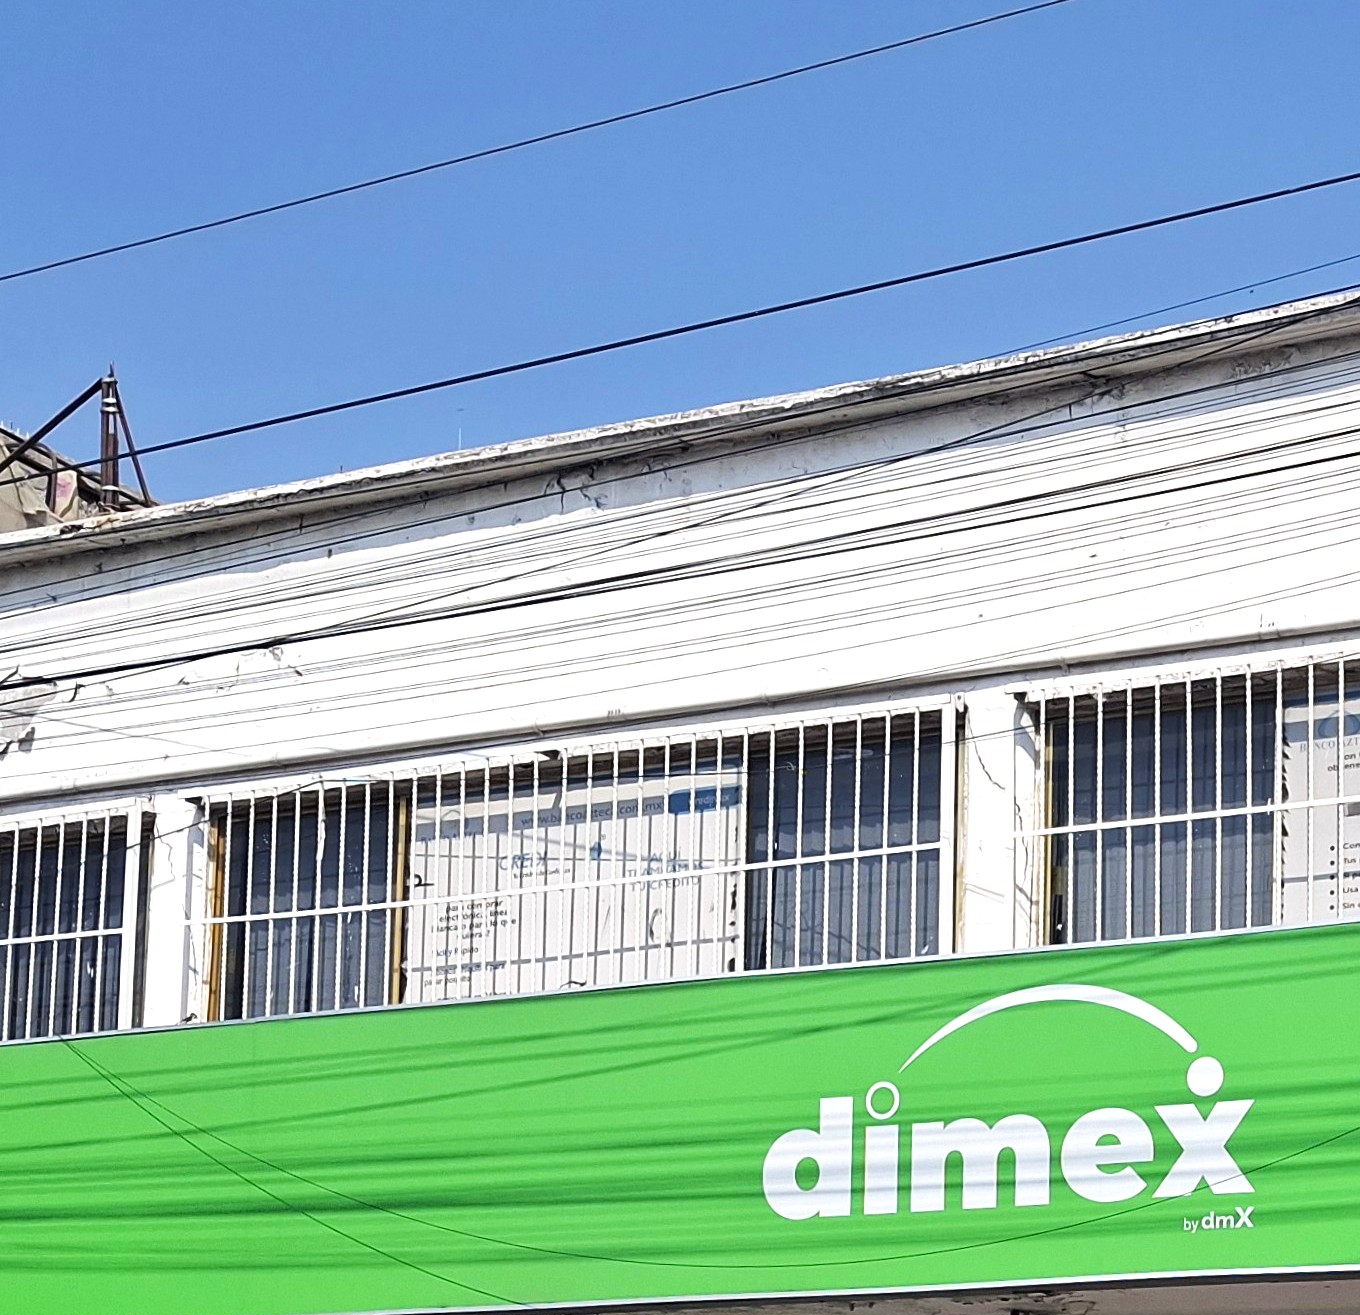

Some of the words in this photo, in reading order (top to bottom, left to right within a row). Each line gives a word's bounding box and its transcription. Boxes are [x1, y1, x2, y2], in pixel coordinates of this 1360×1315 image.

[762, 1056, 1256, 1220] dimex
[1183, 1217, 1199, 1233] by
[1201, 1206, 1255, 1230] dmX
